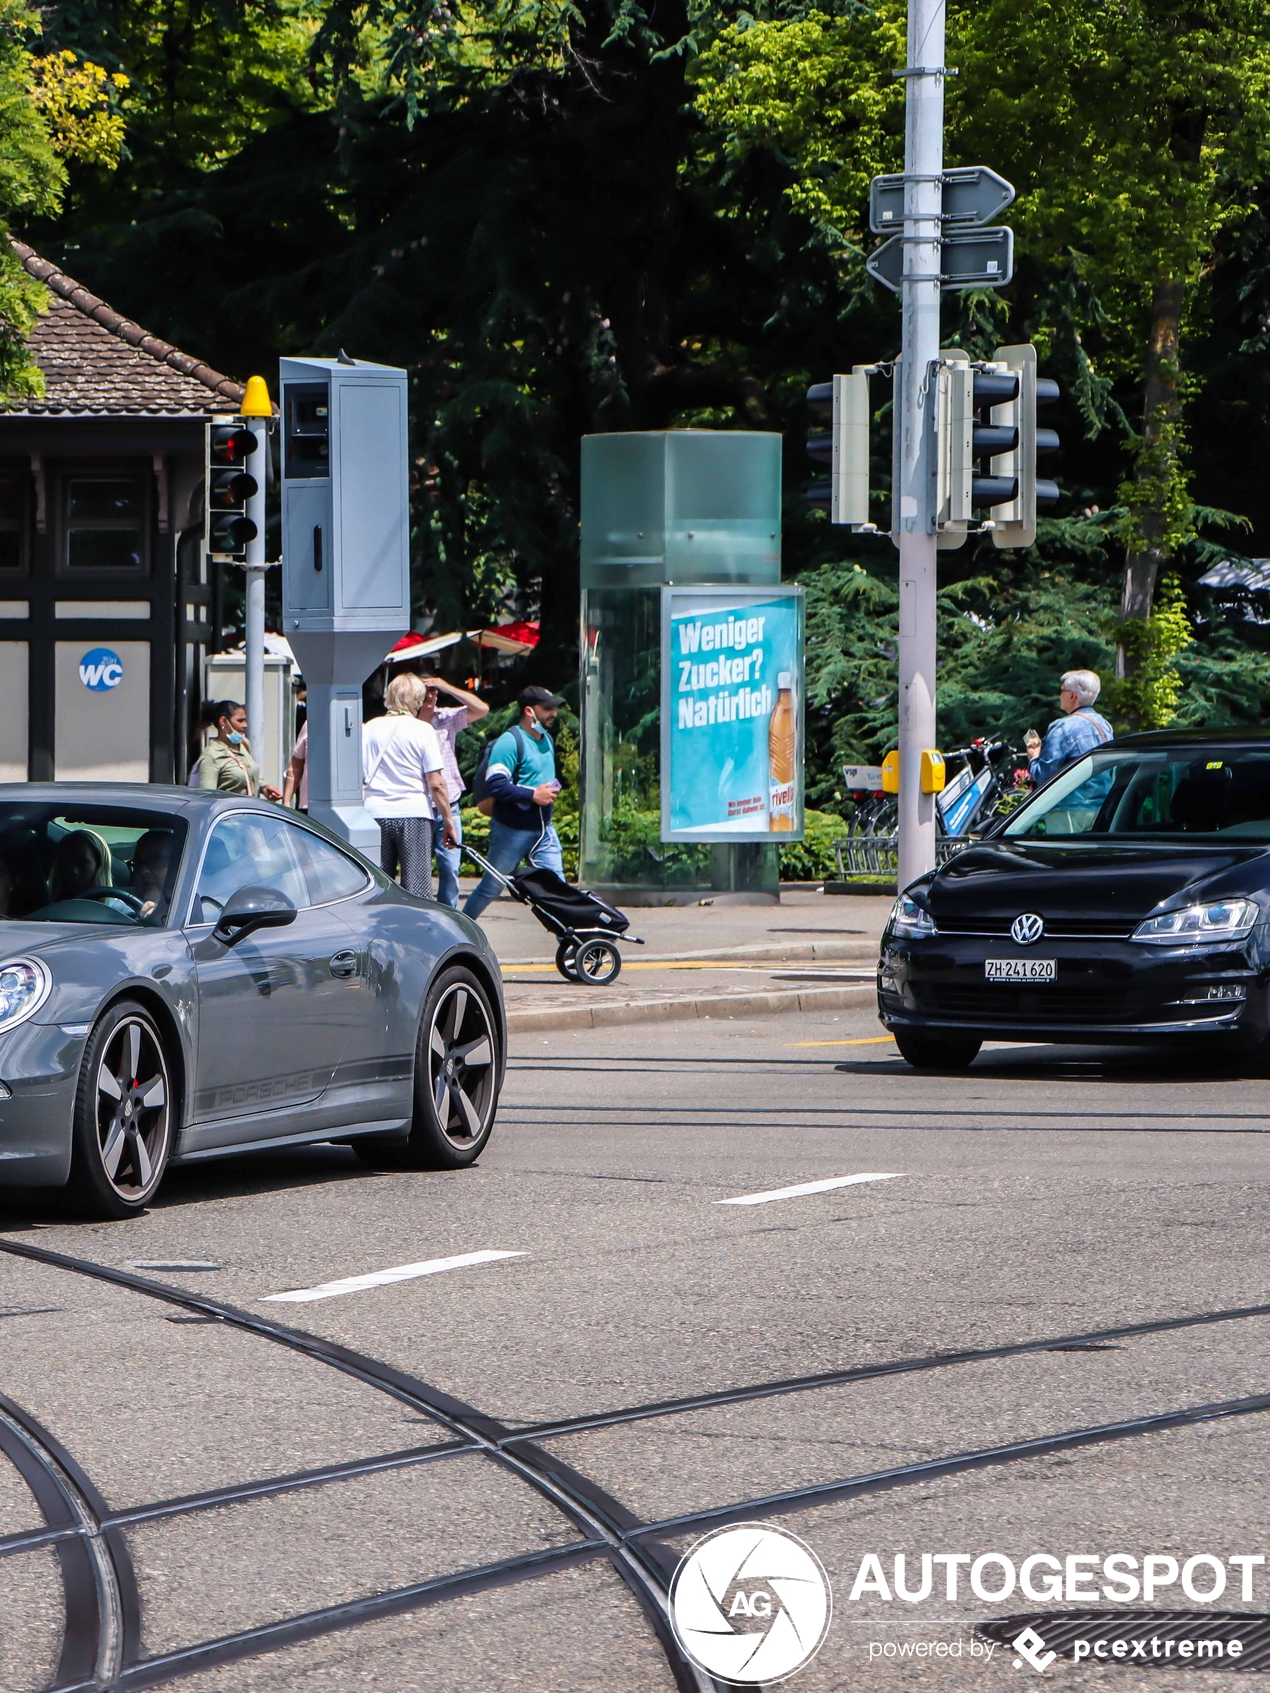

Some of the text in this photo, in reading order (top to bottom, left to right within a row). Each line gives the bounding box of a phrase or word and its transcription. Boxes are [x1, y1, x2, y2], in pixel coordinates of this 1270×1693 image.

[678, 616, 765, 655] Weniger
[79, 664, 123, 686] WC
[678, 648, 764, 692] Zucker?
[678, 684, 771, 730] Natürlich
[1011, 914, 1043, 945] VW
[1030, 962, 1053, 977] 620
[219, 1074, 310, 1106] PORSCHE
